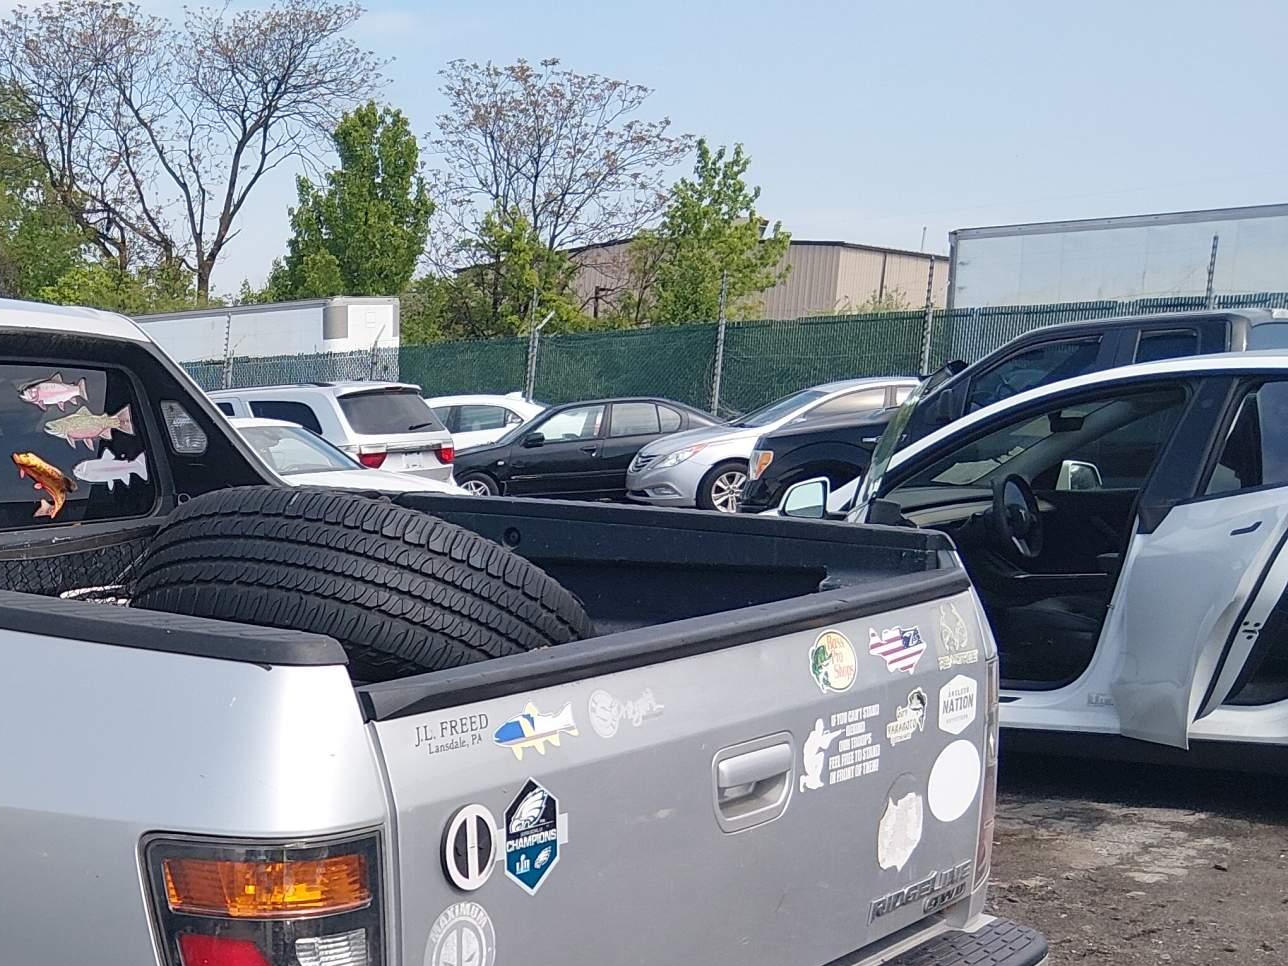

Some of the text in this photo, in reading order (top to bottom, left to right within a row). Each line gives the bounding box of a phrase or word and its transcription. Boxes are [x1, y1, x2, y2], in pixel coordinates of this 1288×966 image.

[942, 693, 974, 714] NATION
[415, 713, 489, 747] J.L. FREED
[428, 733, 482, 754] Lansdale, PA
[506, 829, 557, 852] CHAMPIONS
[867, 859, 972, 927] RIDGELINE
[432, 903, 488, 942] MAXIMUM
